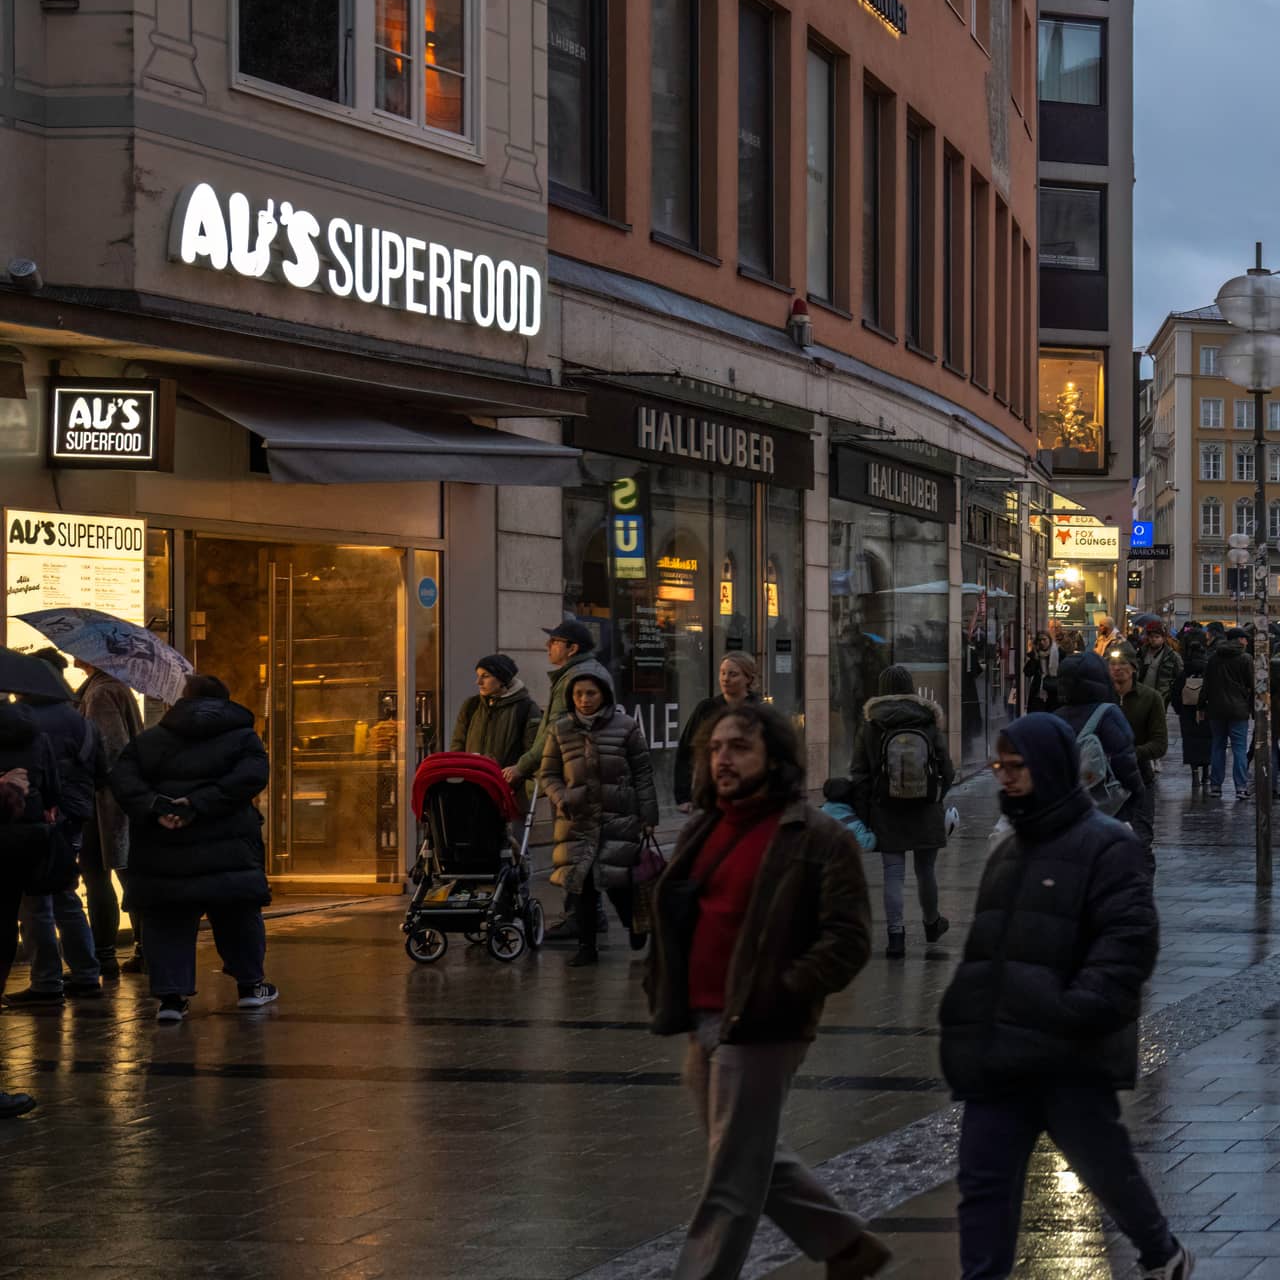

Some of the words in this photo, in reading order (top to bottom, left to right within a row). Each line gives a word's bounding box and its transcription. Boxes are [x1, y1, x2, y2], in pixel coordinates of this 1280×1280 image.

[327, 217, 542, 336] SUPERFOOD
[65, 430, 142, 452] SUPERFOOD
[637, 406, 775, 474] HALLHUBER
[867, 462, 939, 513] HALLHUBER
[57, 521, 143, 552] SUPERFOOD
[1075, 530, 1094, 538] FOX
[1075, 538, 1117, 546] LOUNGES
[616, 702, 680, 750] ALE
